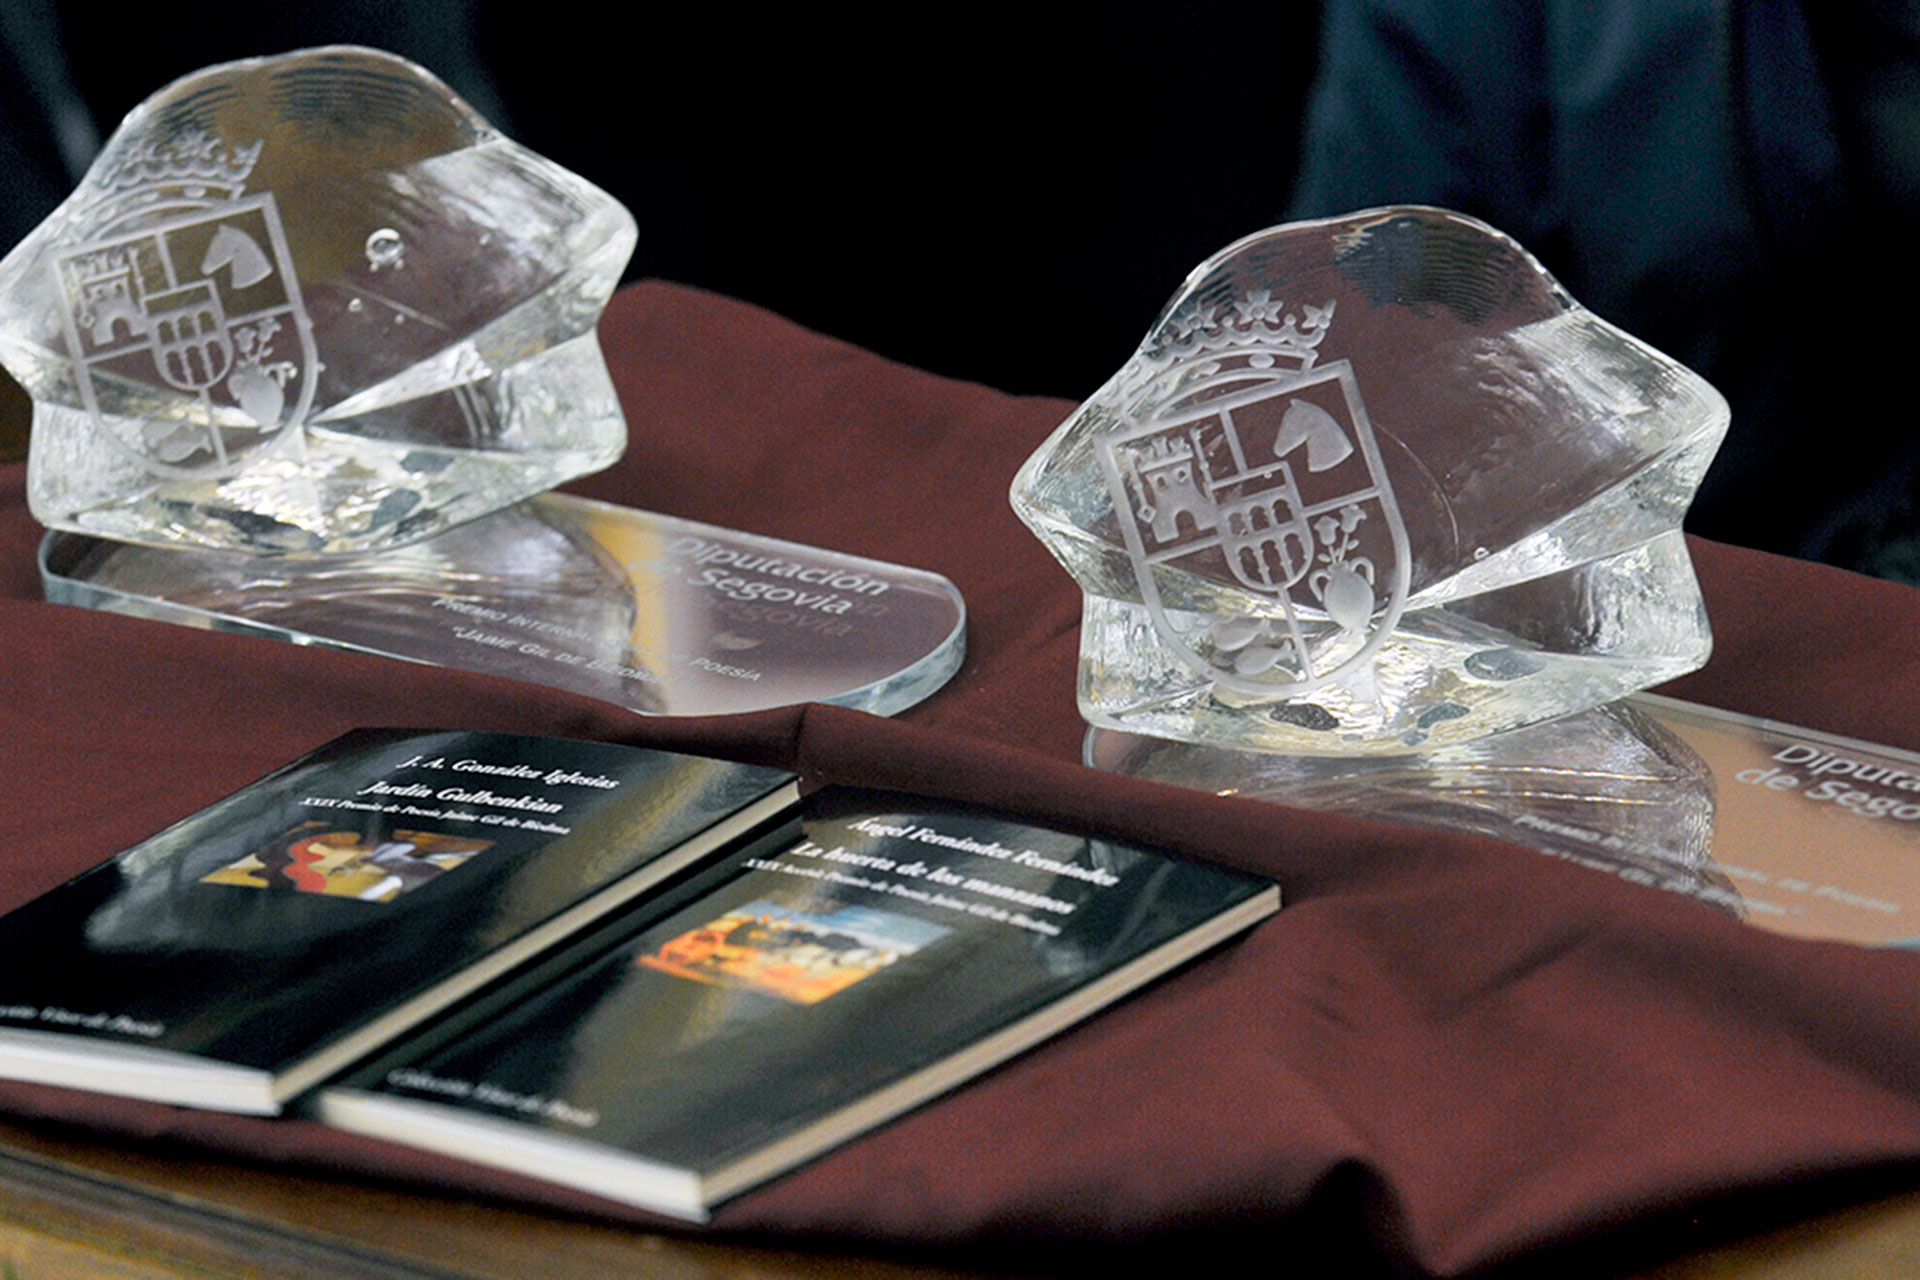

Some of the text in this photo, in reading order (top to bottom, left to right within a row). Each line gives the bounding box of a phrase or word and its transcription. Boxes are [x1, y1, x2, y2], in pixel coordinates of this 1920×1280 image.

[665, 536, 890, 597] Diputación
[687, 567, 853, 616] Segovia
[517, 641, 552, 660] GIL
[688, 656, 762, 683] POESÍA
[396, 755, 621, 790] J. A. González Iglesias
[1734, 766, 1800, 791] de
[435, 787, 563, 815] Gulbenkian
[789, 841, 824, 858] La
[821, 846, 897, 872] huerta
[894, 861, 929, 878] de
[925, 866, 965, 886] los
